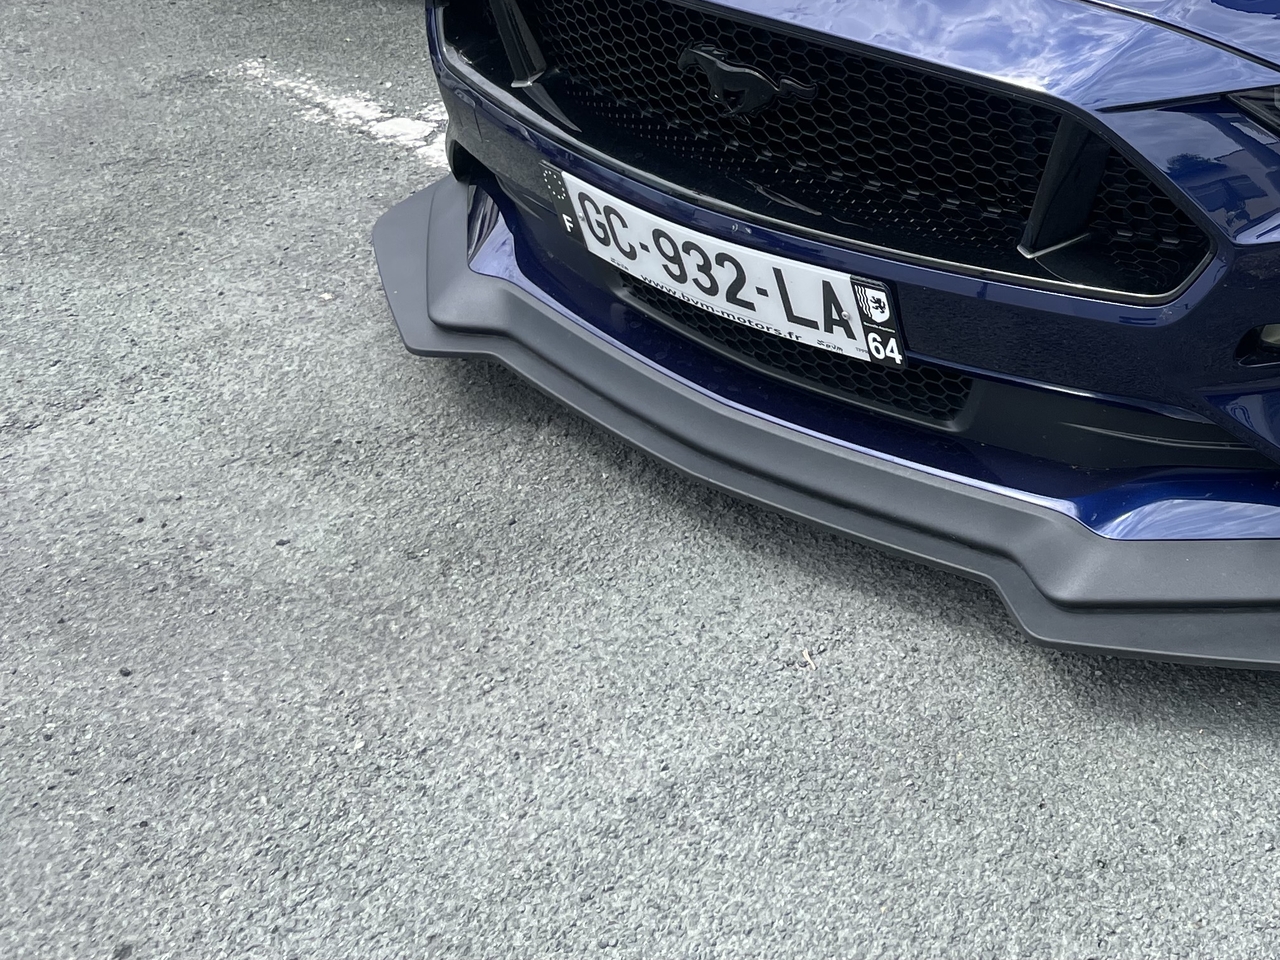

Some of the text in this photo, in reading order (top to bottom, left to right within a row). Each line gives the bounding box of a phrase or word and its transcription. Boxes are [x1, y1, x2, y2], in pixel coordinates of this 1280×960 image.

[562, 213, 574, 233] F
[577, 191, 858, 341] GC-932-LA
[867, 332, 903, 365] 64
